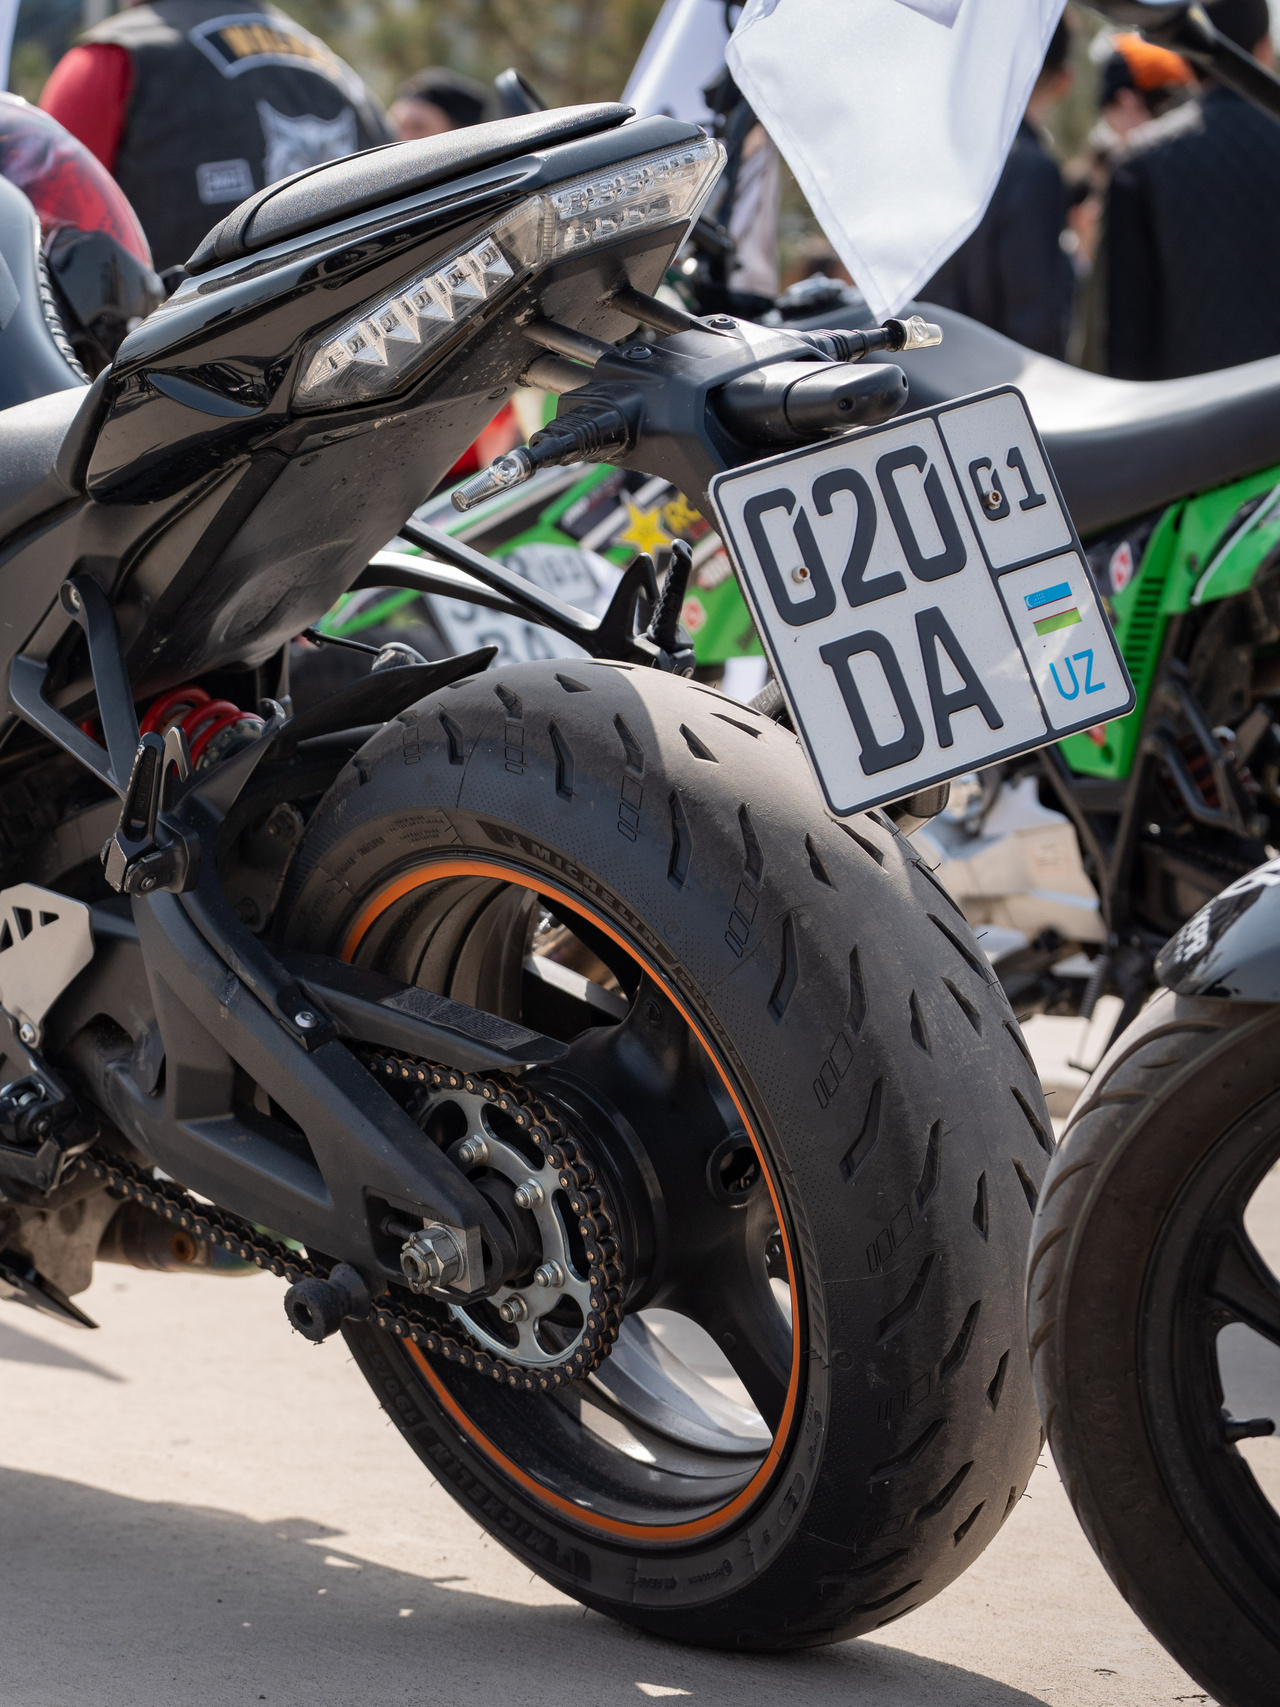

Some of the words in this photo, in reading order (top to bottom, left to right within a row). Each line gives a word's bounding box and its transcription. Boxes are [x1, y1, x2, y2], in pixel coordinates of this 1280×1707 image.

[743, 443, 966, 627] 020
[969, 446, 1047, 521] 01
[819, 606, 1004, 776] DA
[1048, 649, 1106, 701] UZ
[530, 842, 661, 949] MICHELIN
[679, 973, 745, 1069] POWER
[427, 1441, 552, 1554] MICHELIN
